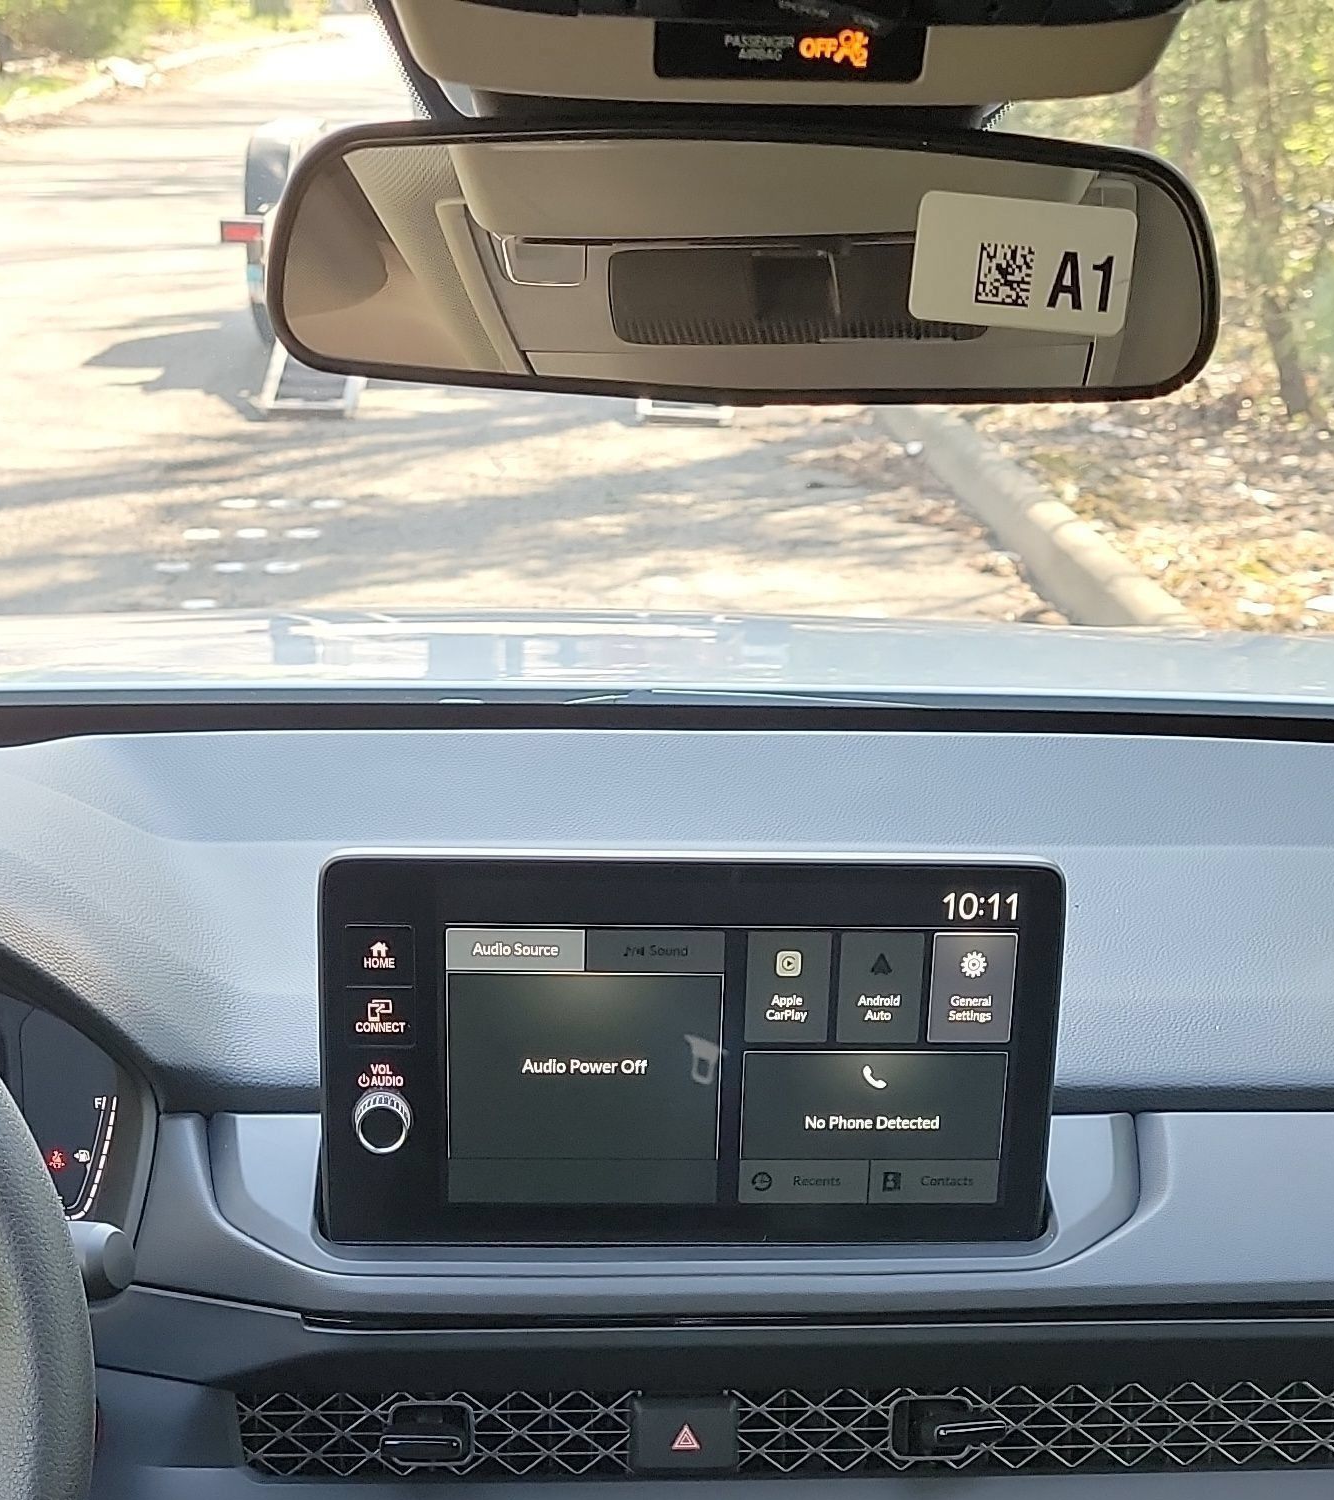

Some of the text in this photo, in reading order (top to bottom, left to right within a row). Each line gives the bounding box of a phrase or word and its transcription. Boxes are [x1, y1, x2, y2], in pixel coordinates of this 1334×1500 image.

[798, 37, 839, 59] OFF
[1046, 250, 1115, 313] A1
[942, 891, 1019, 921] 10:11
[471, 942, 559, 956] Audio Source
[648, 944, 689, 957] Sound
[363, 957, 396, 969] HOME
[770, 994, 803, 1008] Apple
[857, 994, 901, 1007] Android
[949, 995, 992, 1008] General
[765, 1010, 808, 1023] CarPlay
[863, 1009, 892, 1022] Auto
[948, 1010, 992, 1023] Settings
[355, 1021, 406, 1033] CONNECT
[370, 1063, 393, 1075] VOL
[521, 1058, 648, 1075] Audio Power Off
[370, 1076, 404, 1087] AUDIO
[804, 1115, 940, 1130] No Phone Detected
[792, 1175, 842, 1187] Recents
[920, 1175, 974, 1187] Contacts
